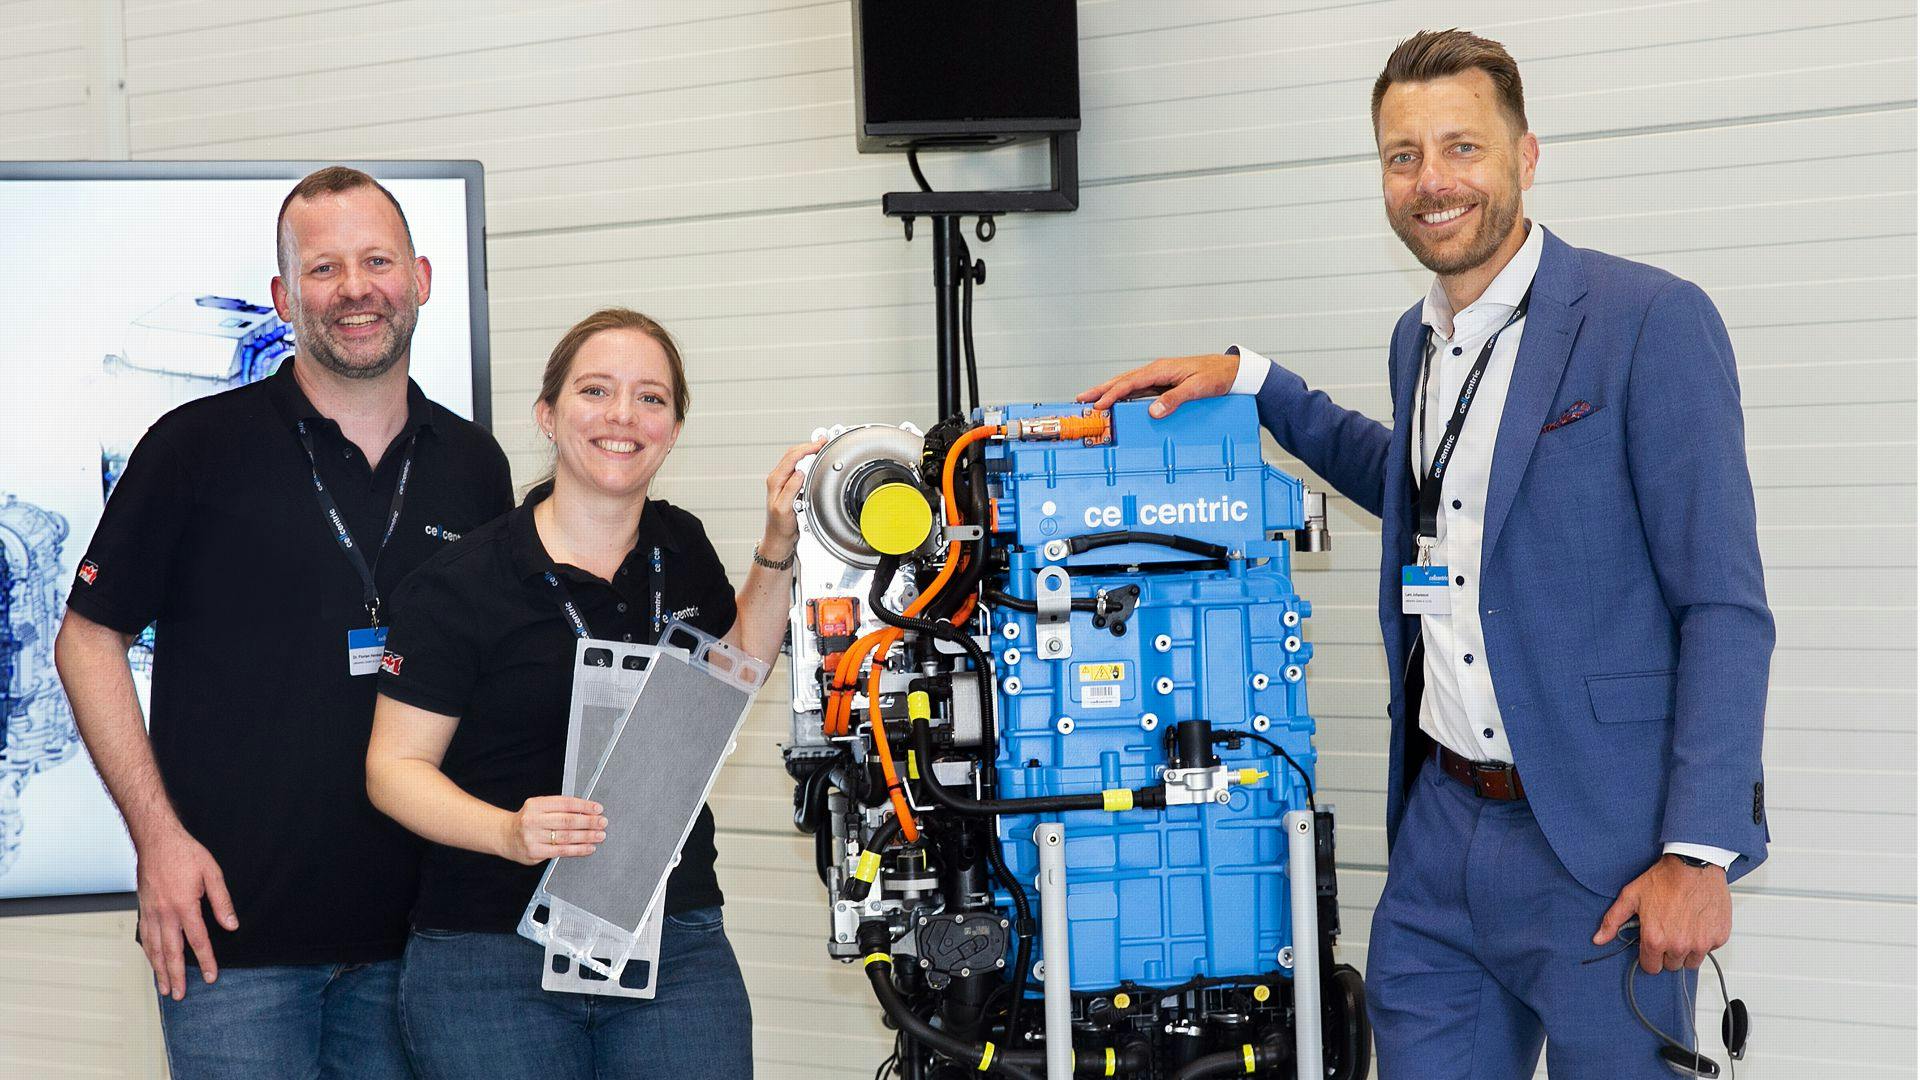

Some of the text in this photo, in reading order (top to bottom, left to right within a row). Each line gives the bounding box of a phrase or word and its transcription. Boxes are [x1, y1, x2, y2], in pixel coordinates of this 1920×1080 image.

[1459, 369, 1481, 414] cellcentric
[1434, 433, 1456, 479] cellcentric
[329, 508, 353, 548] cellcentric
